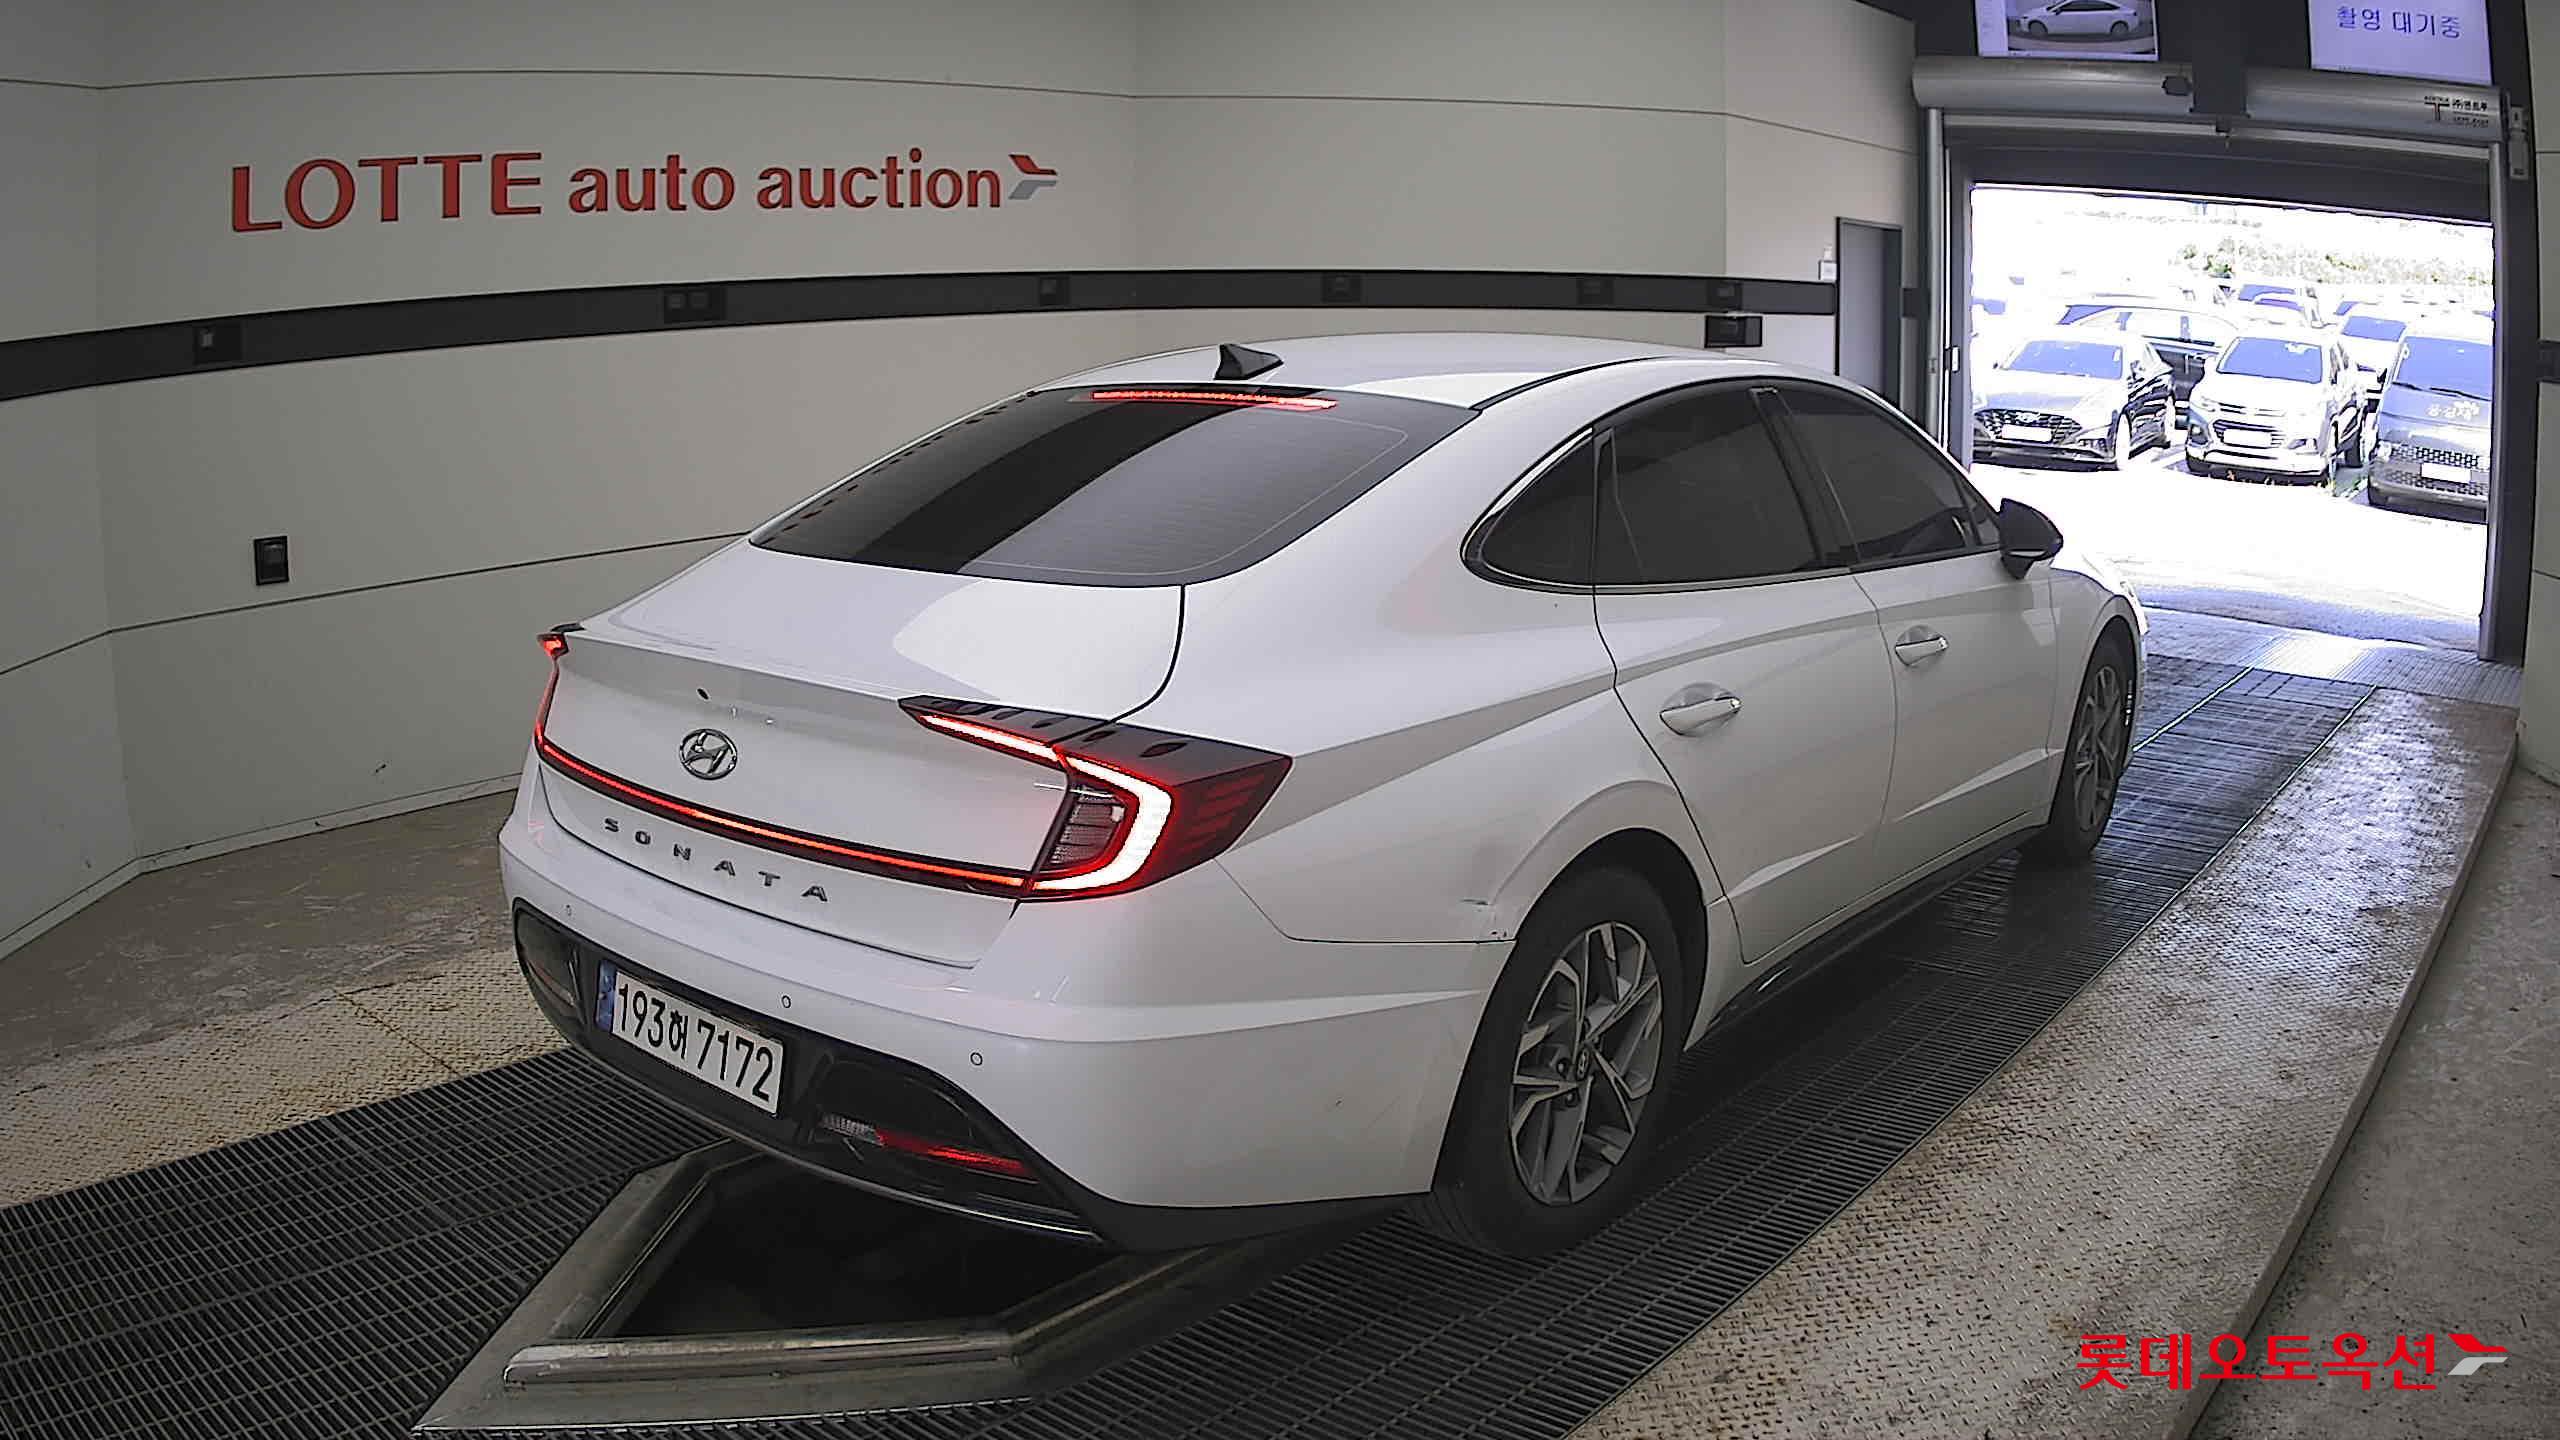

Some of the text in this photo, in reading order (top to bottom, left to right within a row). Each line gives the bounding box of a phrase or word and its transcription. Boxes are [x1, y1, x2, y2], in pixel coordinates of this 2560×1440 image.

[2337, 6, 2461, 38] 촬영 대기중
[232, 148, 1002, 232] LOTTE auto auction
[604, 817, 829, 902] SONATA
